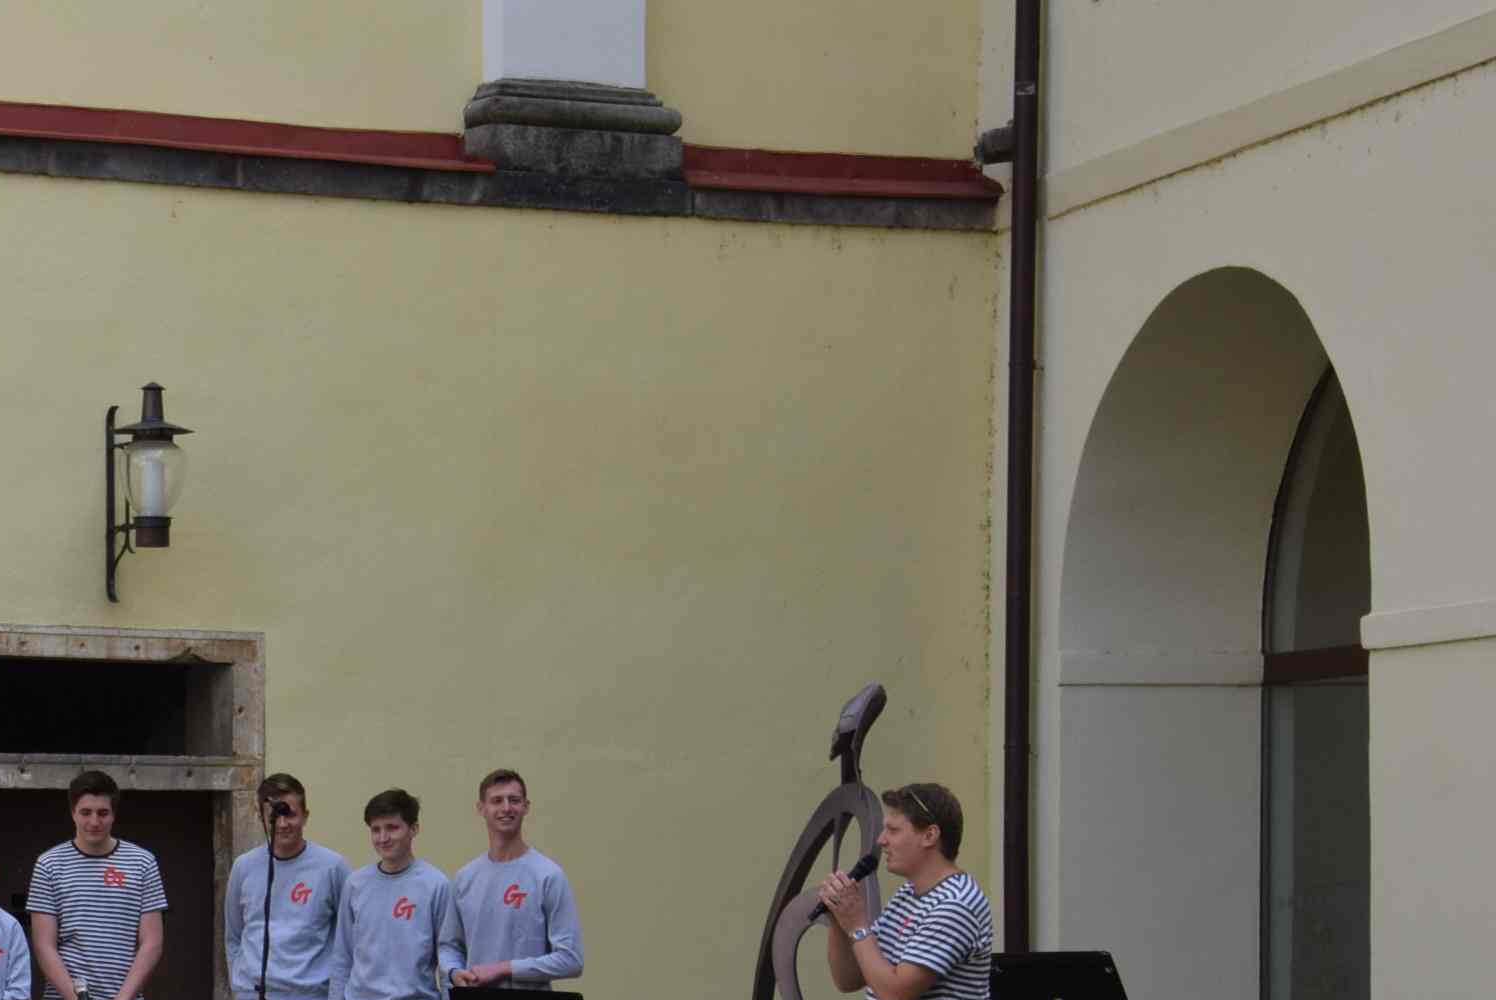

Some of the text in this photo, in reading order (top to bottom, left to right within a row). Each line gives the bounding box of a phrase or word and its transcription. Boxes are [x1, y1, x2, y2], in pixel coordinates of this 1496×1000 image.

[290, 881, 313, 905] GT
[503, 884, 529, 909] GT
[391, 896, 416, 920] GT
